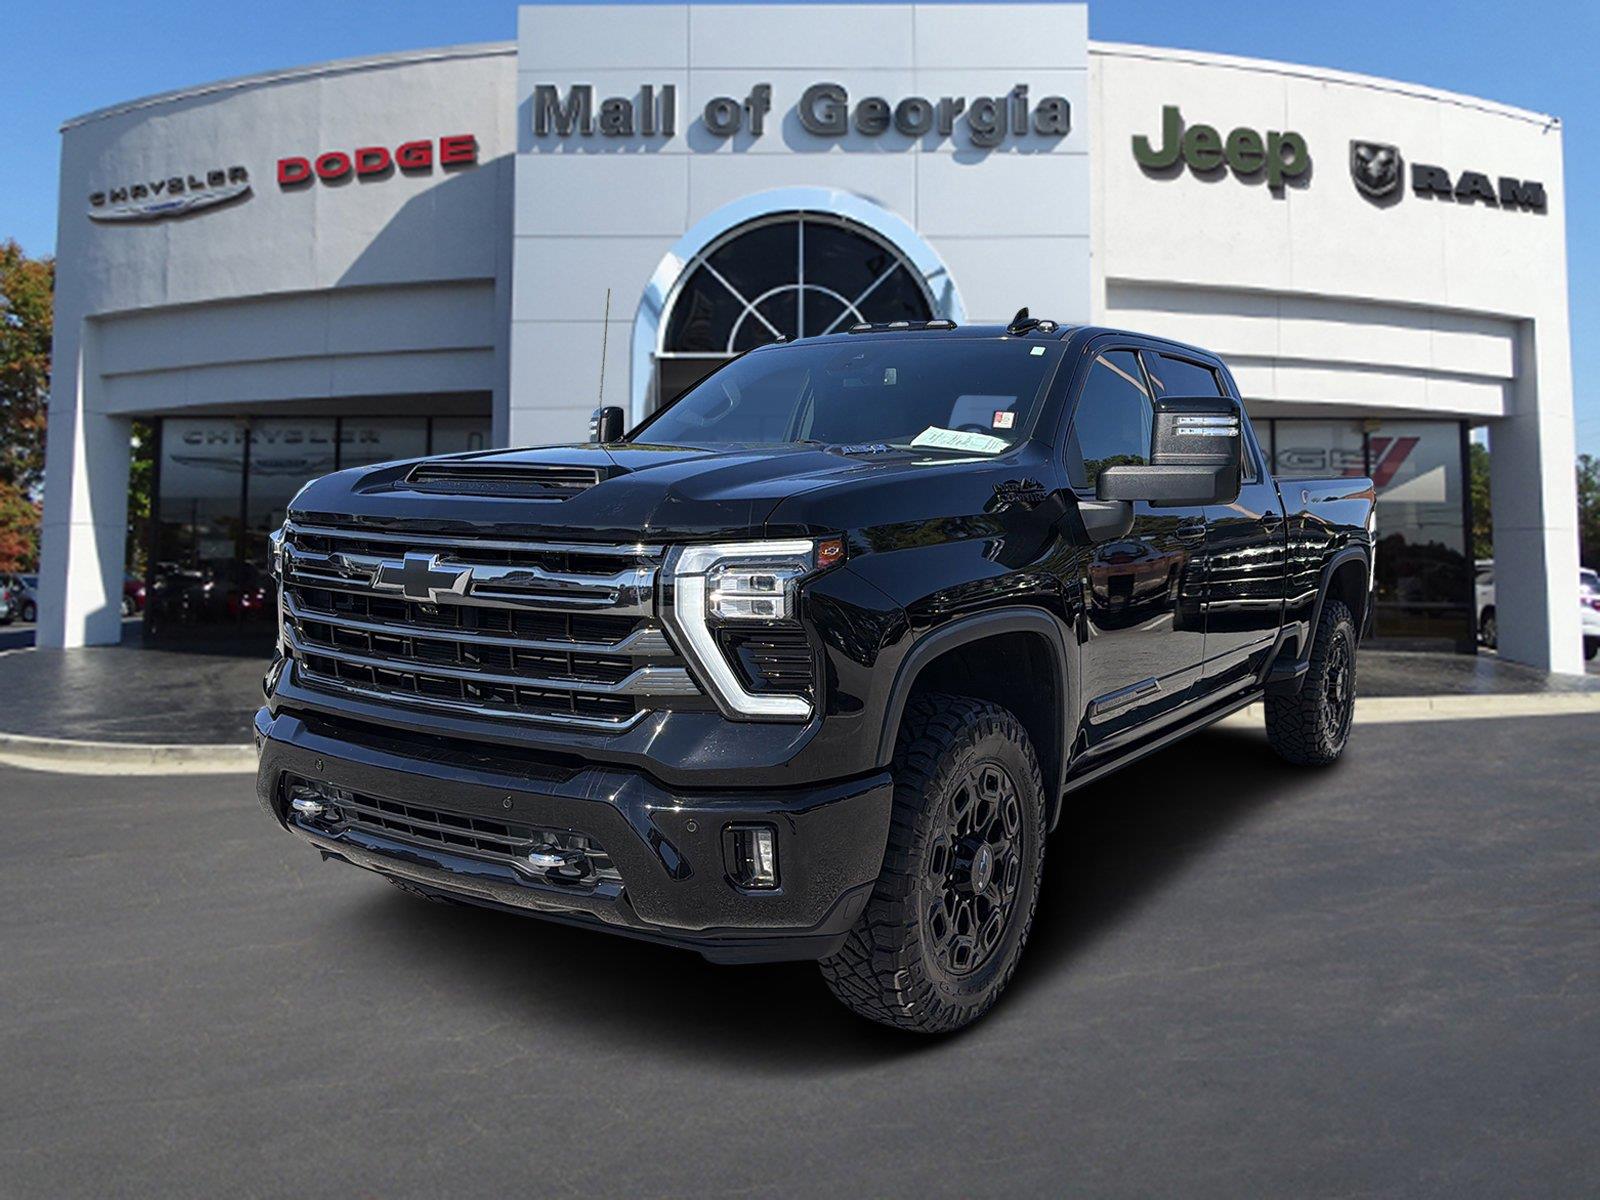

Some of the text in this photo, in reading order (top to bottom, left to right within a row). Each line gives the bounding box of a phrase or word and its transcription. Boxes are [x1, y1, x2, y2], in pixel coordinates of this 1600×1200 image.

[532, 83, 1072, 148] Mall of Georgia
[276, 134, 478, 185] DODGE
[1131, 104, 1311, 194] Jeep
[89, 166, 249, 207] CHRYSLER
[1410, 163, 1547, 211] RAM
[183, 428, 381, 445] CHRYSLER
